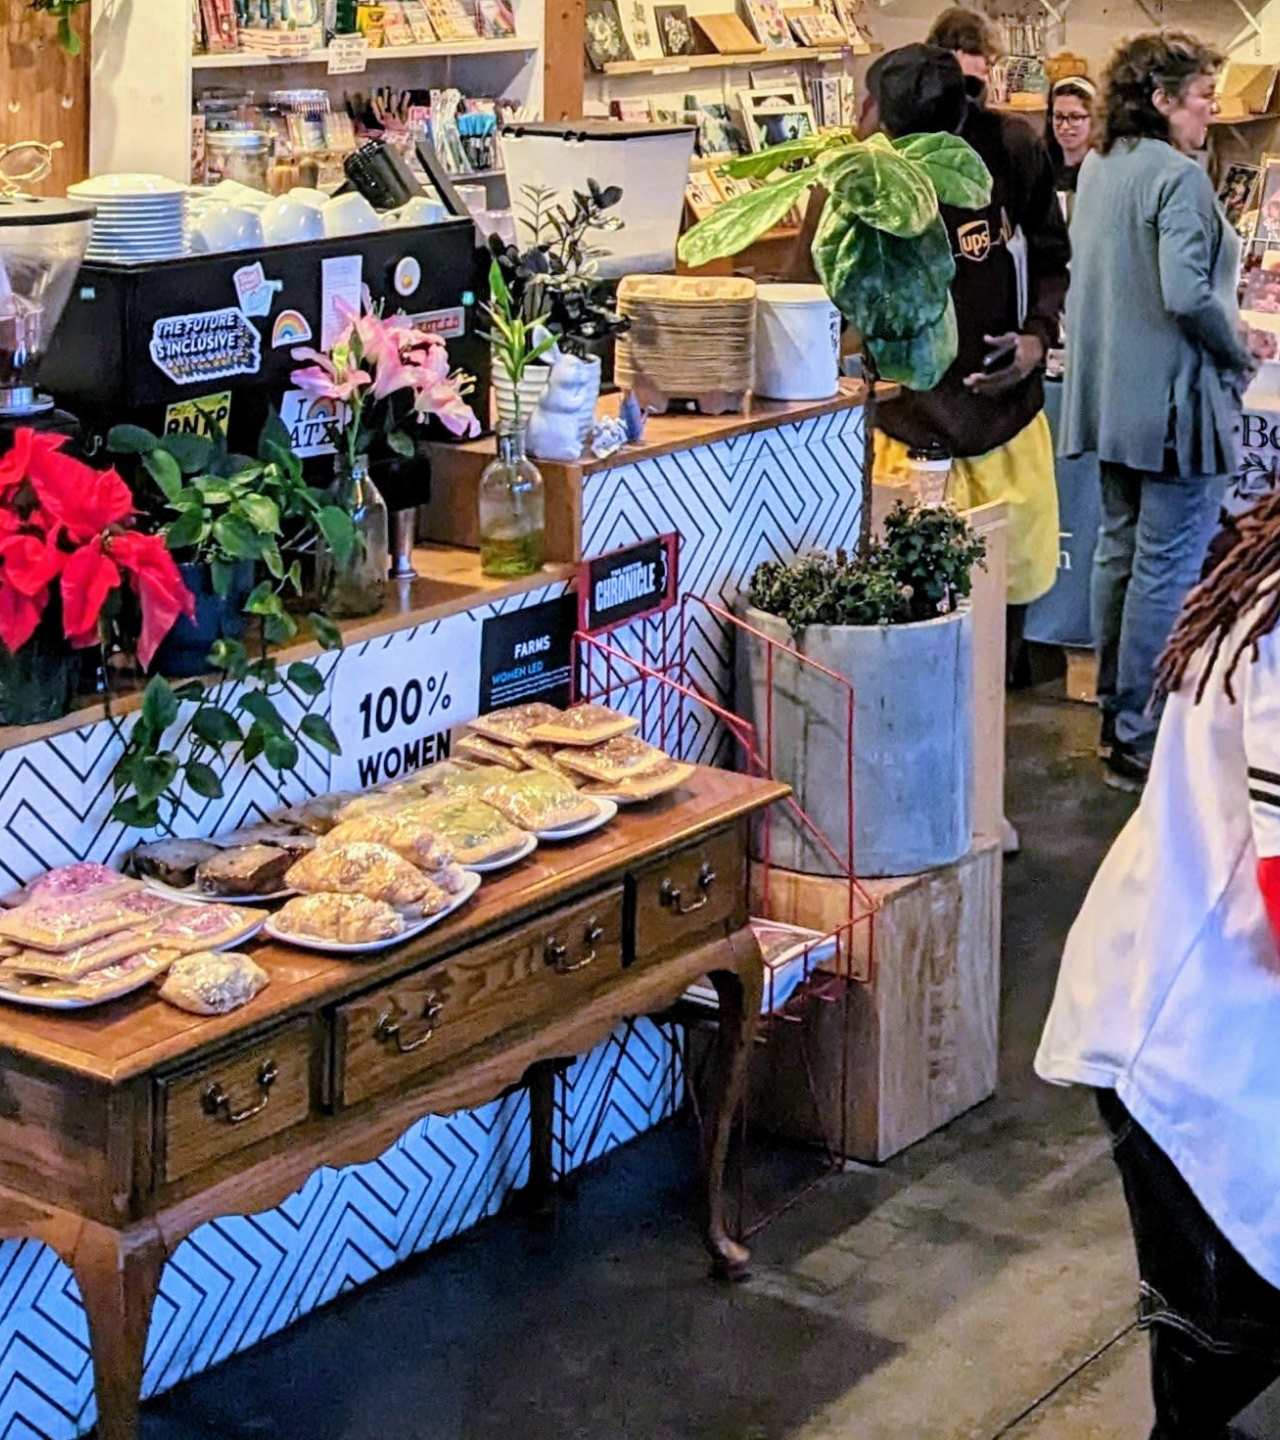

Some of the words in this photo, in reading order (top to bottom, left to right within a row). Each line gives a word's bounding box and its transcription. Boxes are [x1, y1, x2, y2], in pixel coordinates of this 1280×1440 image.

[962, 231, 989, 256] ups
[184, 312, 236, 332] FUTURE
[167, 333, 236, 355] INCLUSIVE
[291, 420, 339, 448] ATX
[596, 563, 656, 612] CHRONICLE
[514, 635, 551, 659] FARMS
[492, 665, 527, 685] WOMEN
[528, 661, 544, 674] LED
[359, 671, 452, 739] 100%
[358, 729, 452, 788] WOMEN
